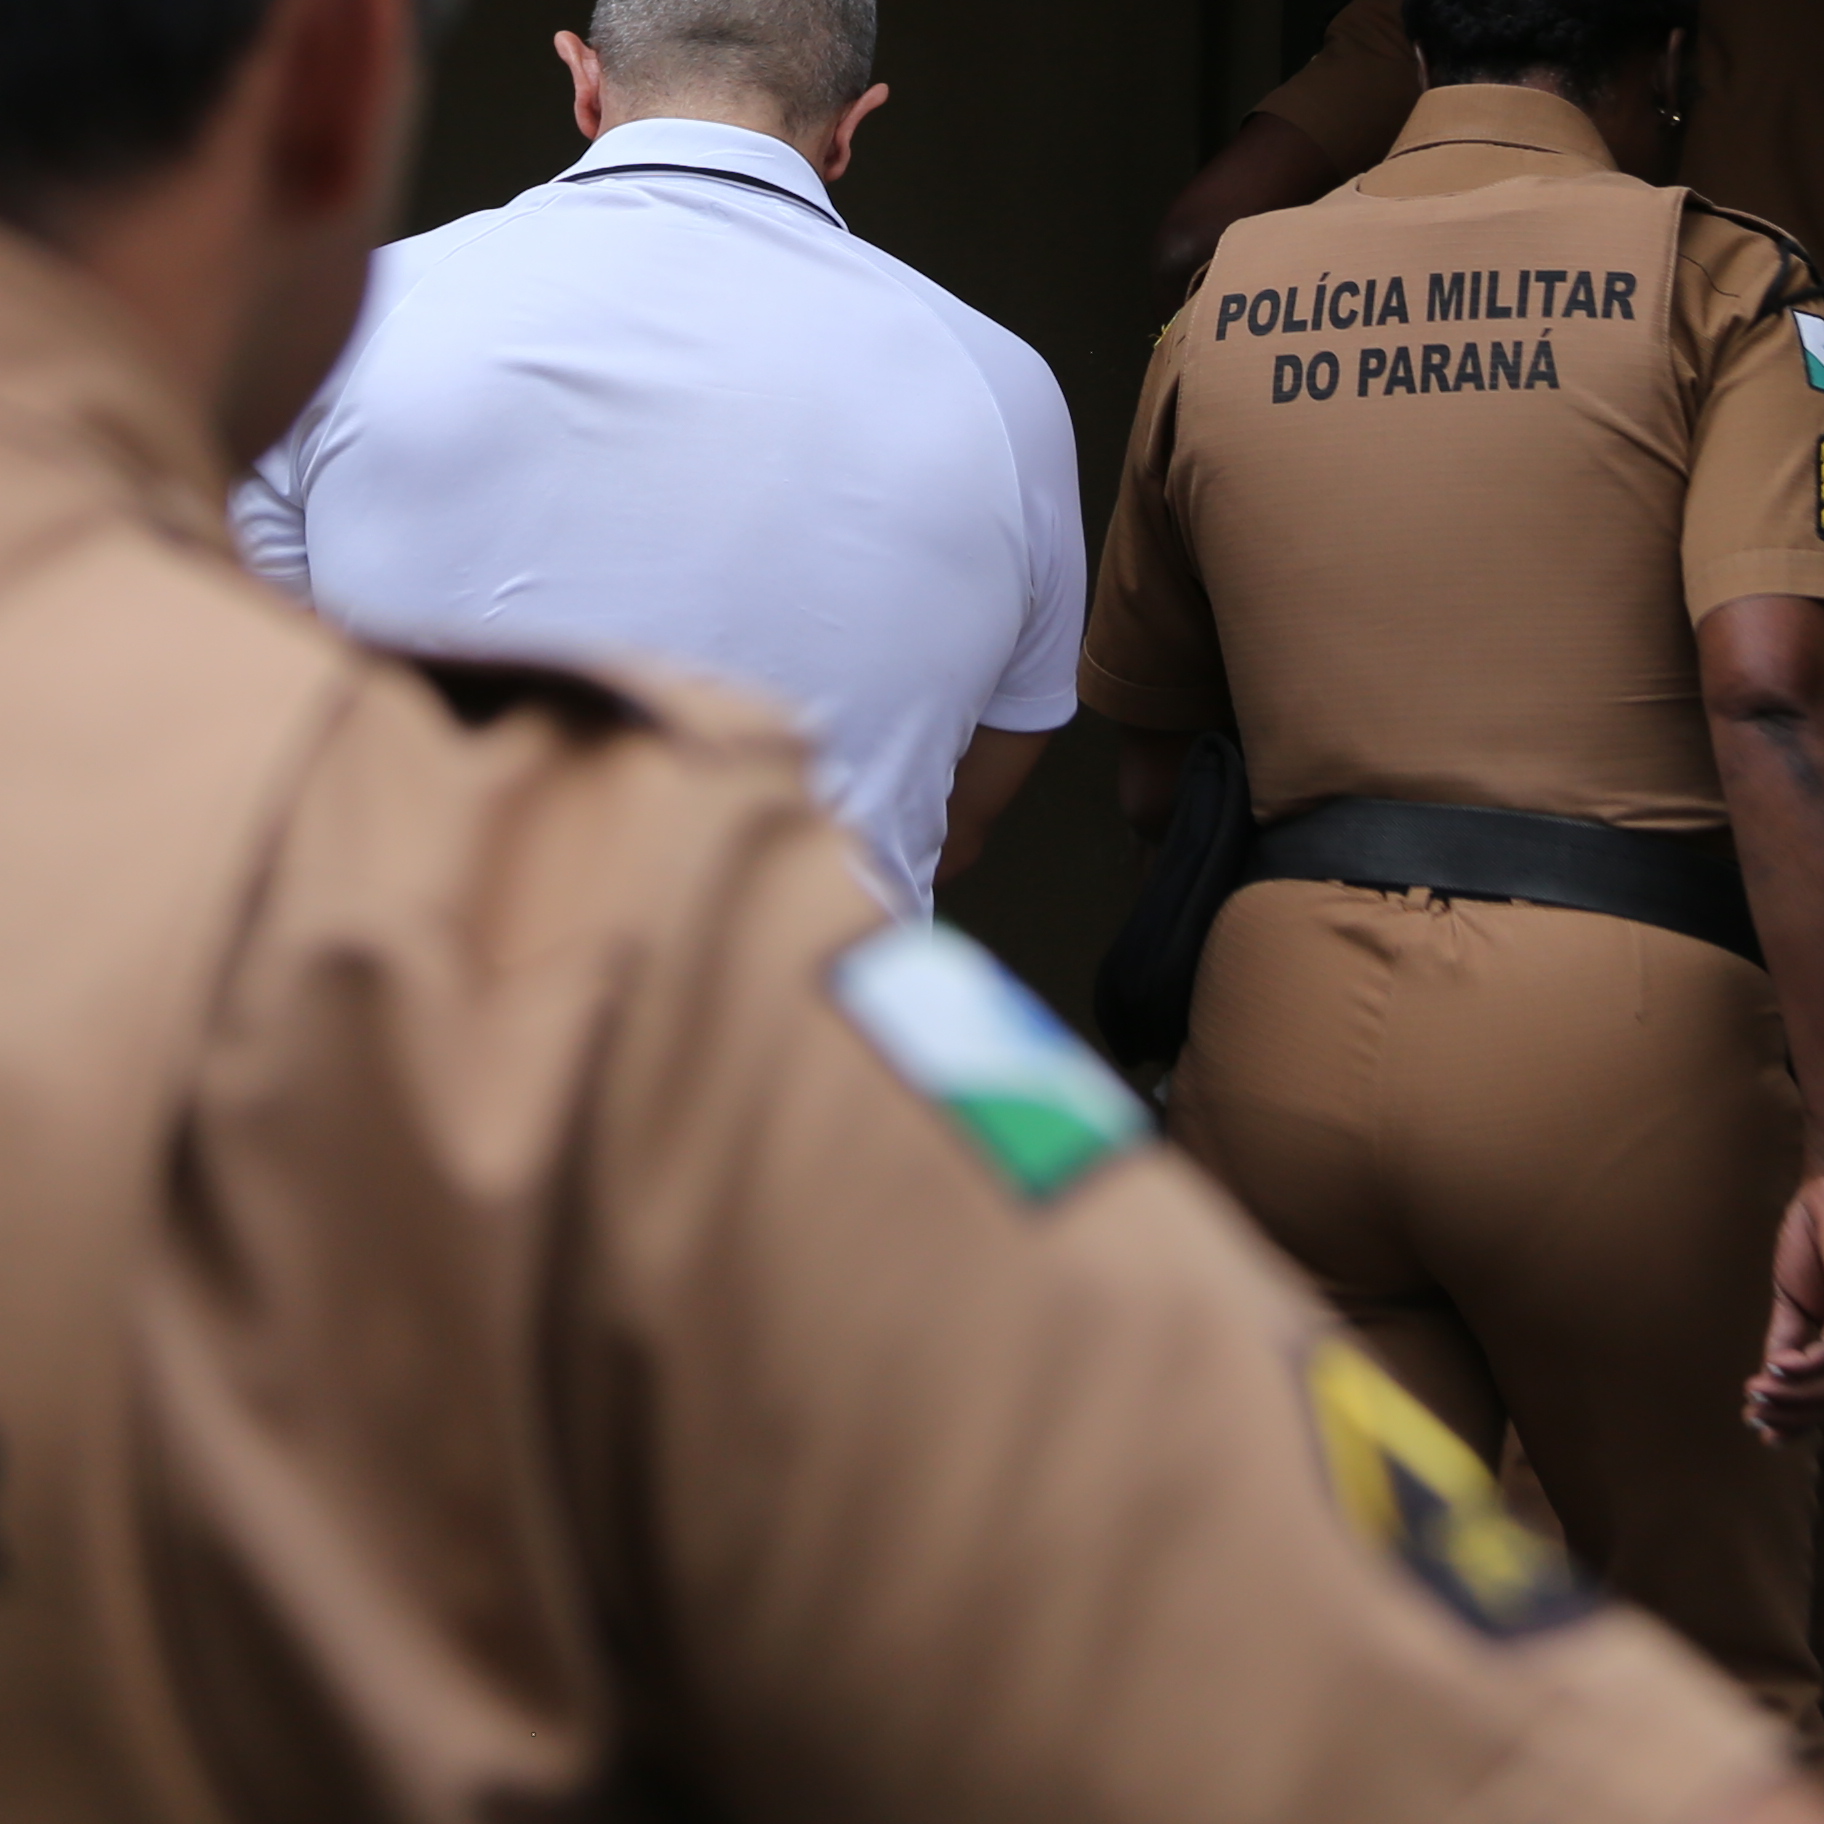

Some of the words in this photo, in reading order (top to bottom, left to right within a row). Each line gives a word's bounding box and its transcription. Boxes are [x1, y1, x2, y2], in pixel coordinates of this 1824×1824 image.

[1215, 272, 1410, 341] POLÍCIA
[1425, 269, 1638, 325] MILITAR
[1271, 352, 1340, 404] DO
[1356, 328, 1561, 399] PARANÁ
